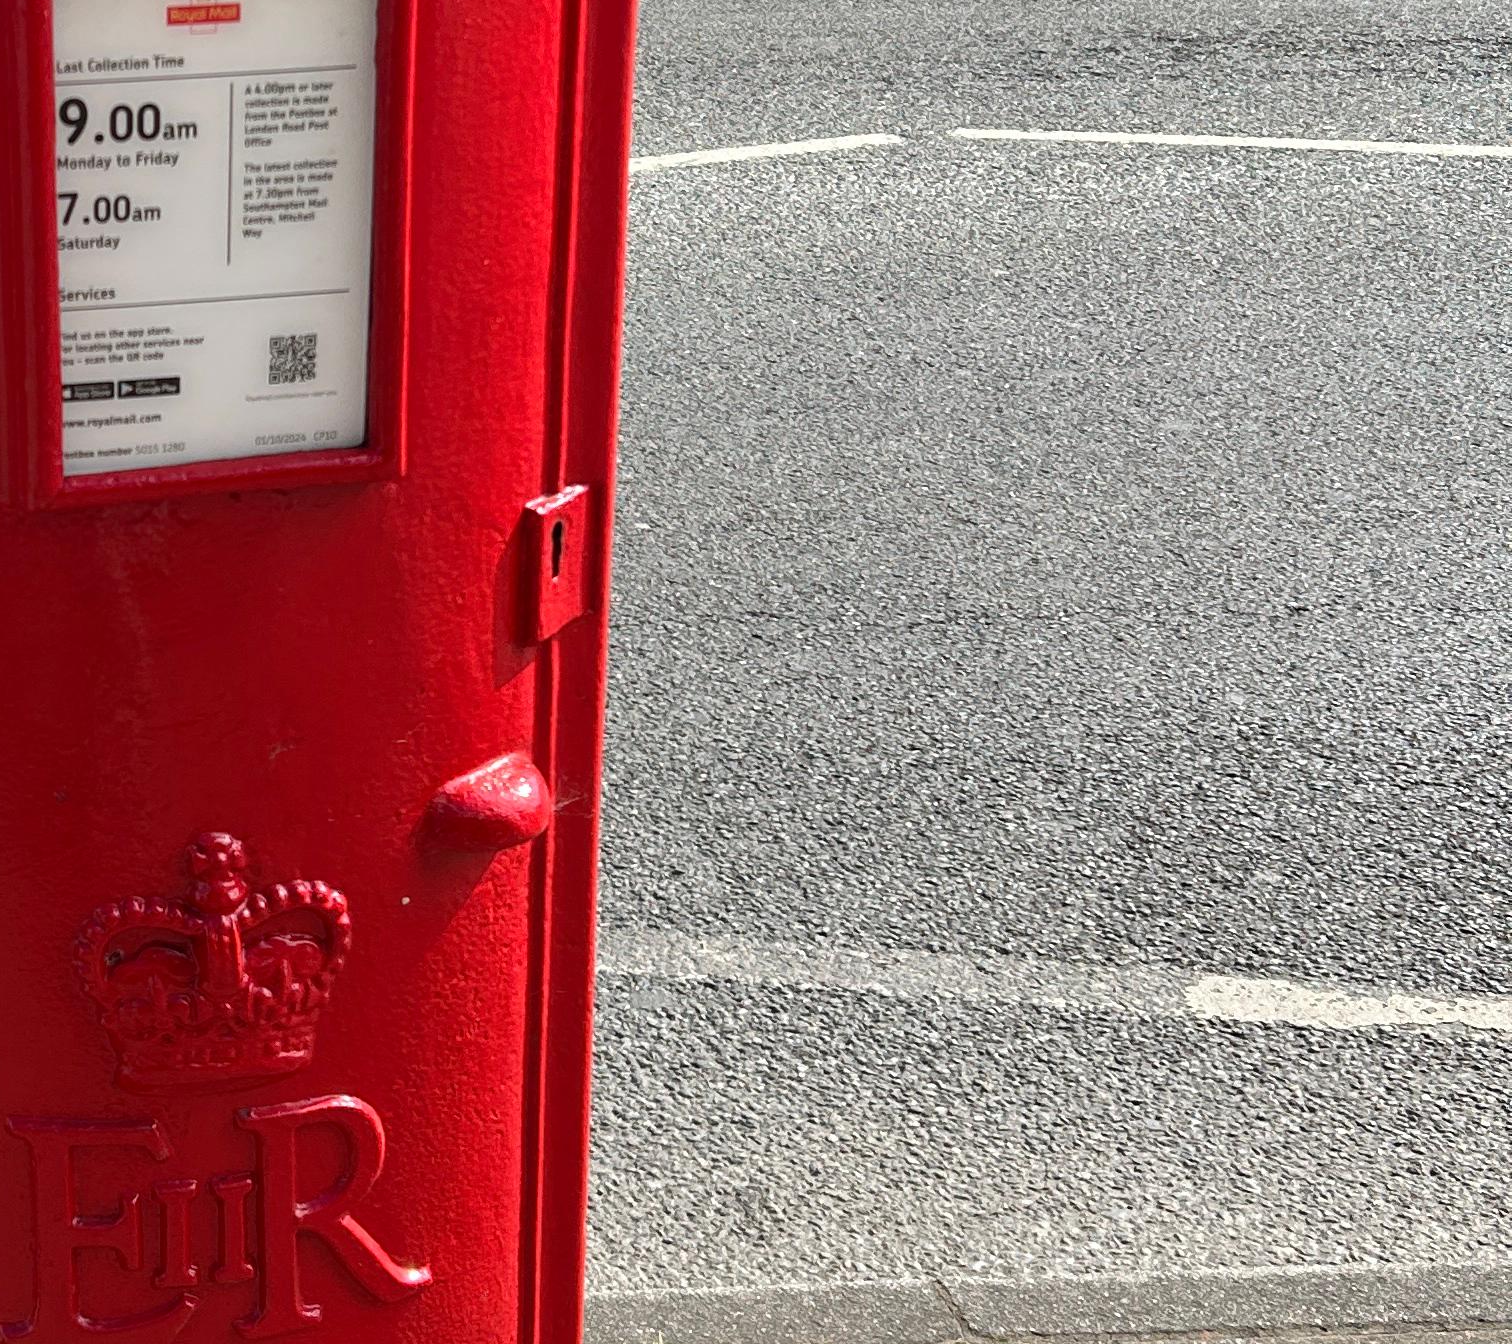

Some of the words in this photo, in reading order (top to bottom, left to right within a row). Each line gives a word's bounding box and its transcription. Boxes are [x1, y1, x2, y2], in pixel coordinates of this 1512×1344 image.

[170, 7, 206, 23] Royal
[208, 4, 237, 19] Mail
[56, 59, 84, 75] Last
[87, 56, 149, 73] Collection
[153, 53, 184, 69] Time
[59, 98, 198, 146] 9.00am
[57, 156, 111, 171] Monday
[117, 154, 131, 168] to
[136, 150, 179, 167] Friday
[58, 193, 161, 225] 7.00am
[57, 235, 120, 251] Saturday
[59, 287, 116, 302] Services
[63, 450, 94, 460] ostbox
